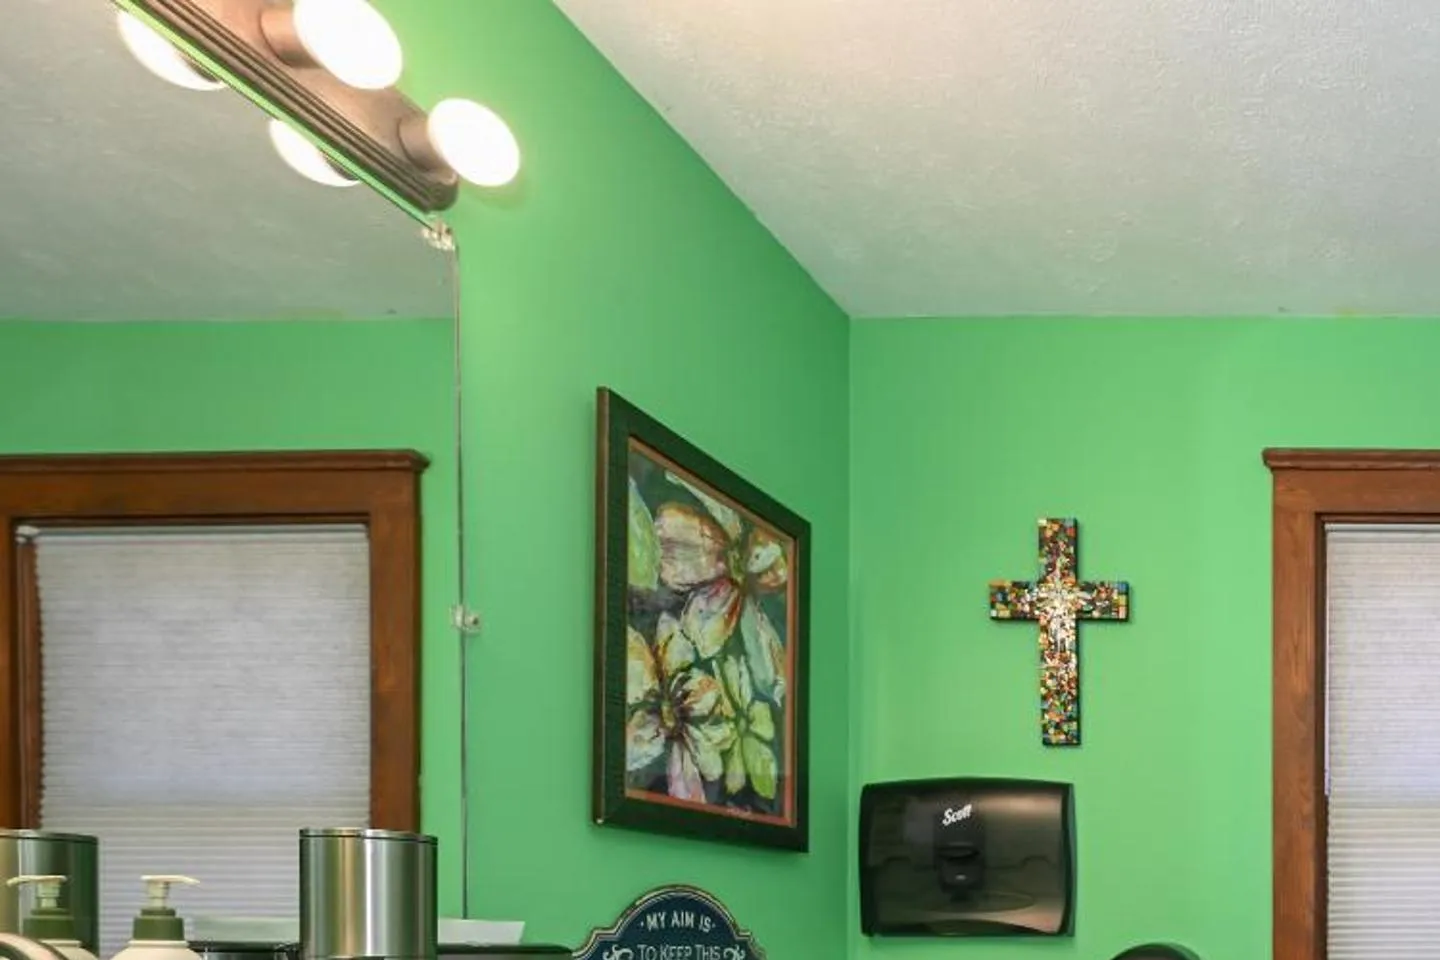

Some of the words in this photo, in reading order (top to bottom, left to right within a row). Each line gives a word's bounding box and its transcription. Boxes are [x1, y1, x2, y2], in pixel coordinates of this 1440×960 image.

[942, 803, 973, 827] Scott
[646, 911, 666, 932] MY
[671, 910, 694, 929] AIM
[699, 914, 711, 933] IS
